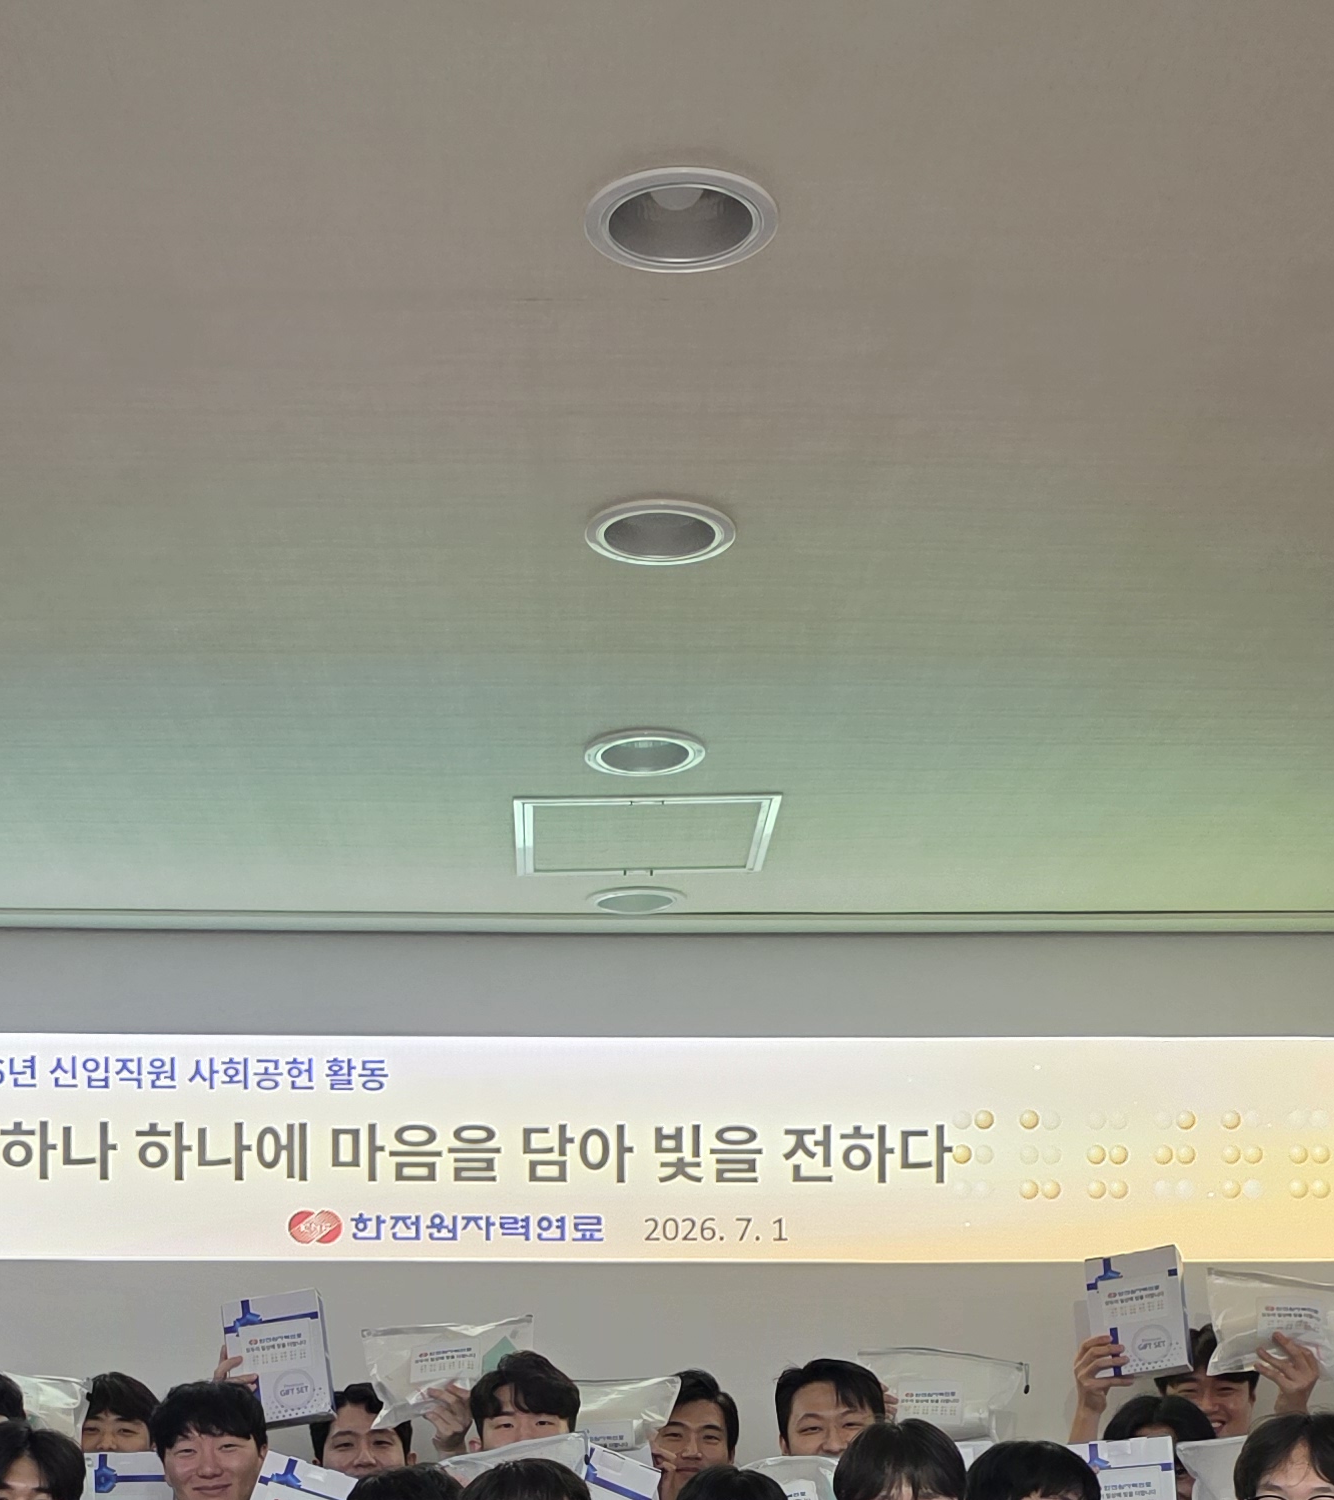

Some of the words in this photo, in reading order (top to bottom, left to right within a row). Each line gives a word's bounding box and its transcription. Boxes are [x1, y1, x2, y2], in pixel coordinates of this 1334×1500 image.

[48, 1056, 177, 1089] 신입직원
[188, 1058, 315, 1090] 사회공헌
[324, 1058, 389, 1091] 활동
[0, 1120, 118, 1180] 하나
[135, 1121, 309, 1181] 하나에
[331, 1123, 502, 1182] 마음을
[522, 1123, 633, 1183] 담아
[654, 1124, 763, 1183] 빛을
[782, 1124, 953, 1184] 전하다
[350, 1212, 605, 1243] 한전원자력연료
[643, 1218, 724, 1242] 2026.
[736, 1218, 760, 1242] 7.
[773, 1218, 788, 1241] 1
